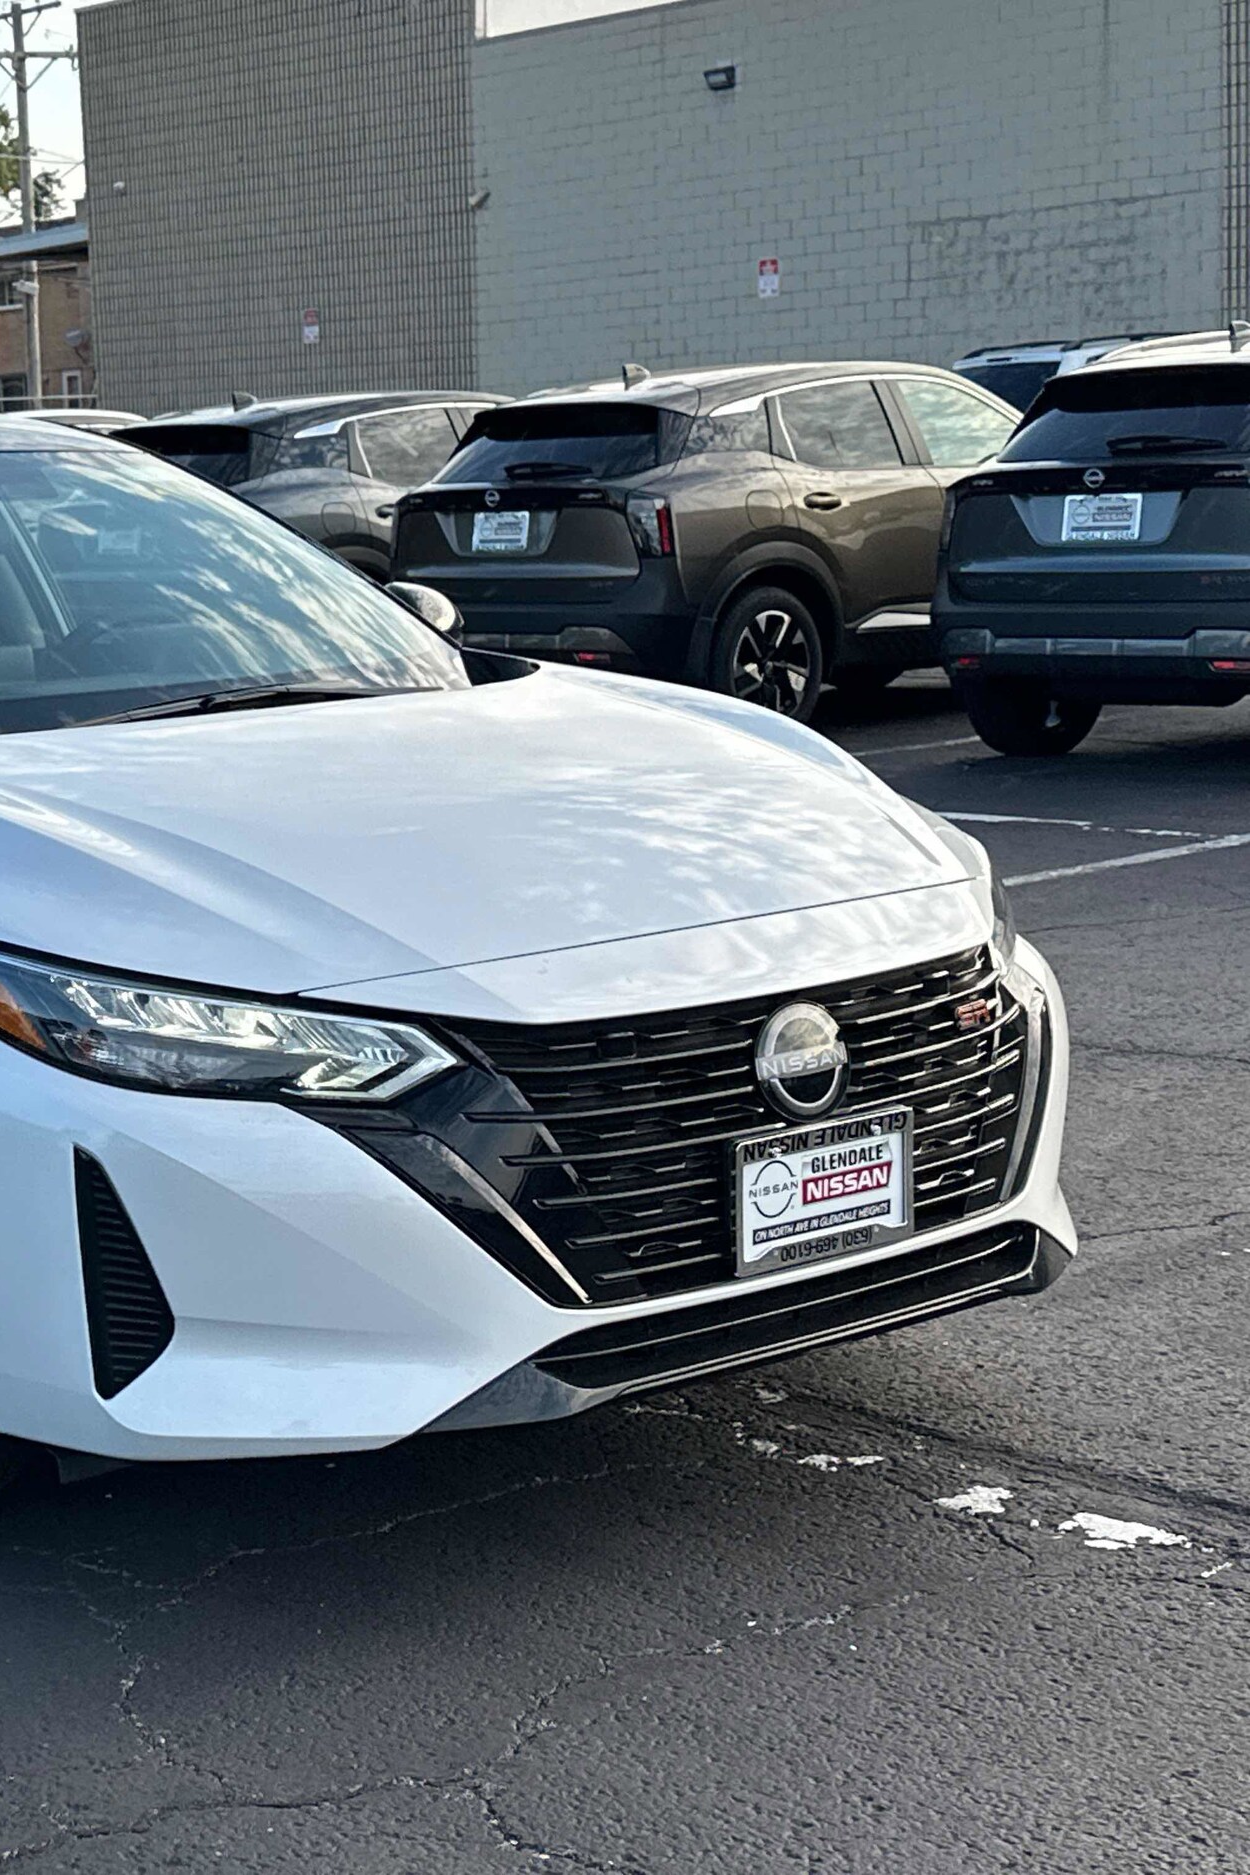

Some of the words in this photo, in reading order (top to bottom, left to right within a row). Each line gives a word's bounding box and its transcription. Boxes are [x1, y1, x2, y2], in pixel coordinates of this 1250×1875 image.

[761, 1045, 845, 1079] NISSAN
[814, 1112, 907, 1143] GLENDALE
[743, 1130, 809, 1162] NISSAN
[811, 1144, 883, 1174] GLENDALE
[748, 1180, 799, 1198] NISSAN
[806, 1166, 887, 1201] NISSAN
[754, 1230, 767, 1242] ON
[768, 1224, 794, 1238] NORTH
[794, 1220, 810, 1233] AVE
[810, 1218, 819, 1229] IN
[819, 1209, 857, 1228] GLENDALE
[858, 1202, 888, 1218] HEIGHTS
[842, 1225, 872, 1249] (630)
[781, 1235, 839, 1262] 469-6100
